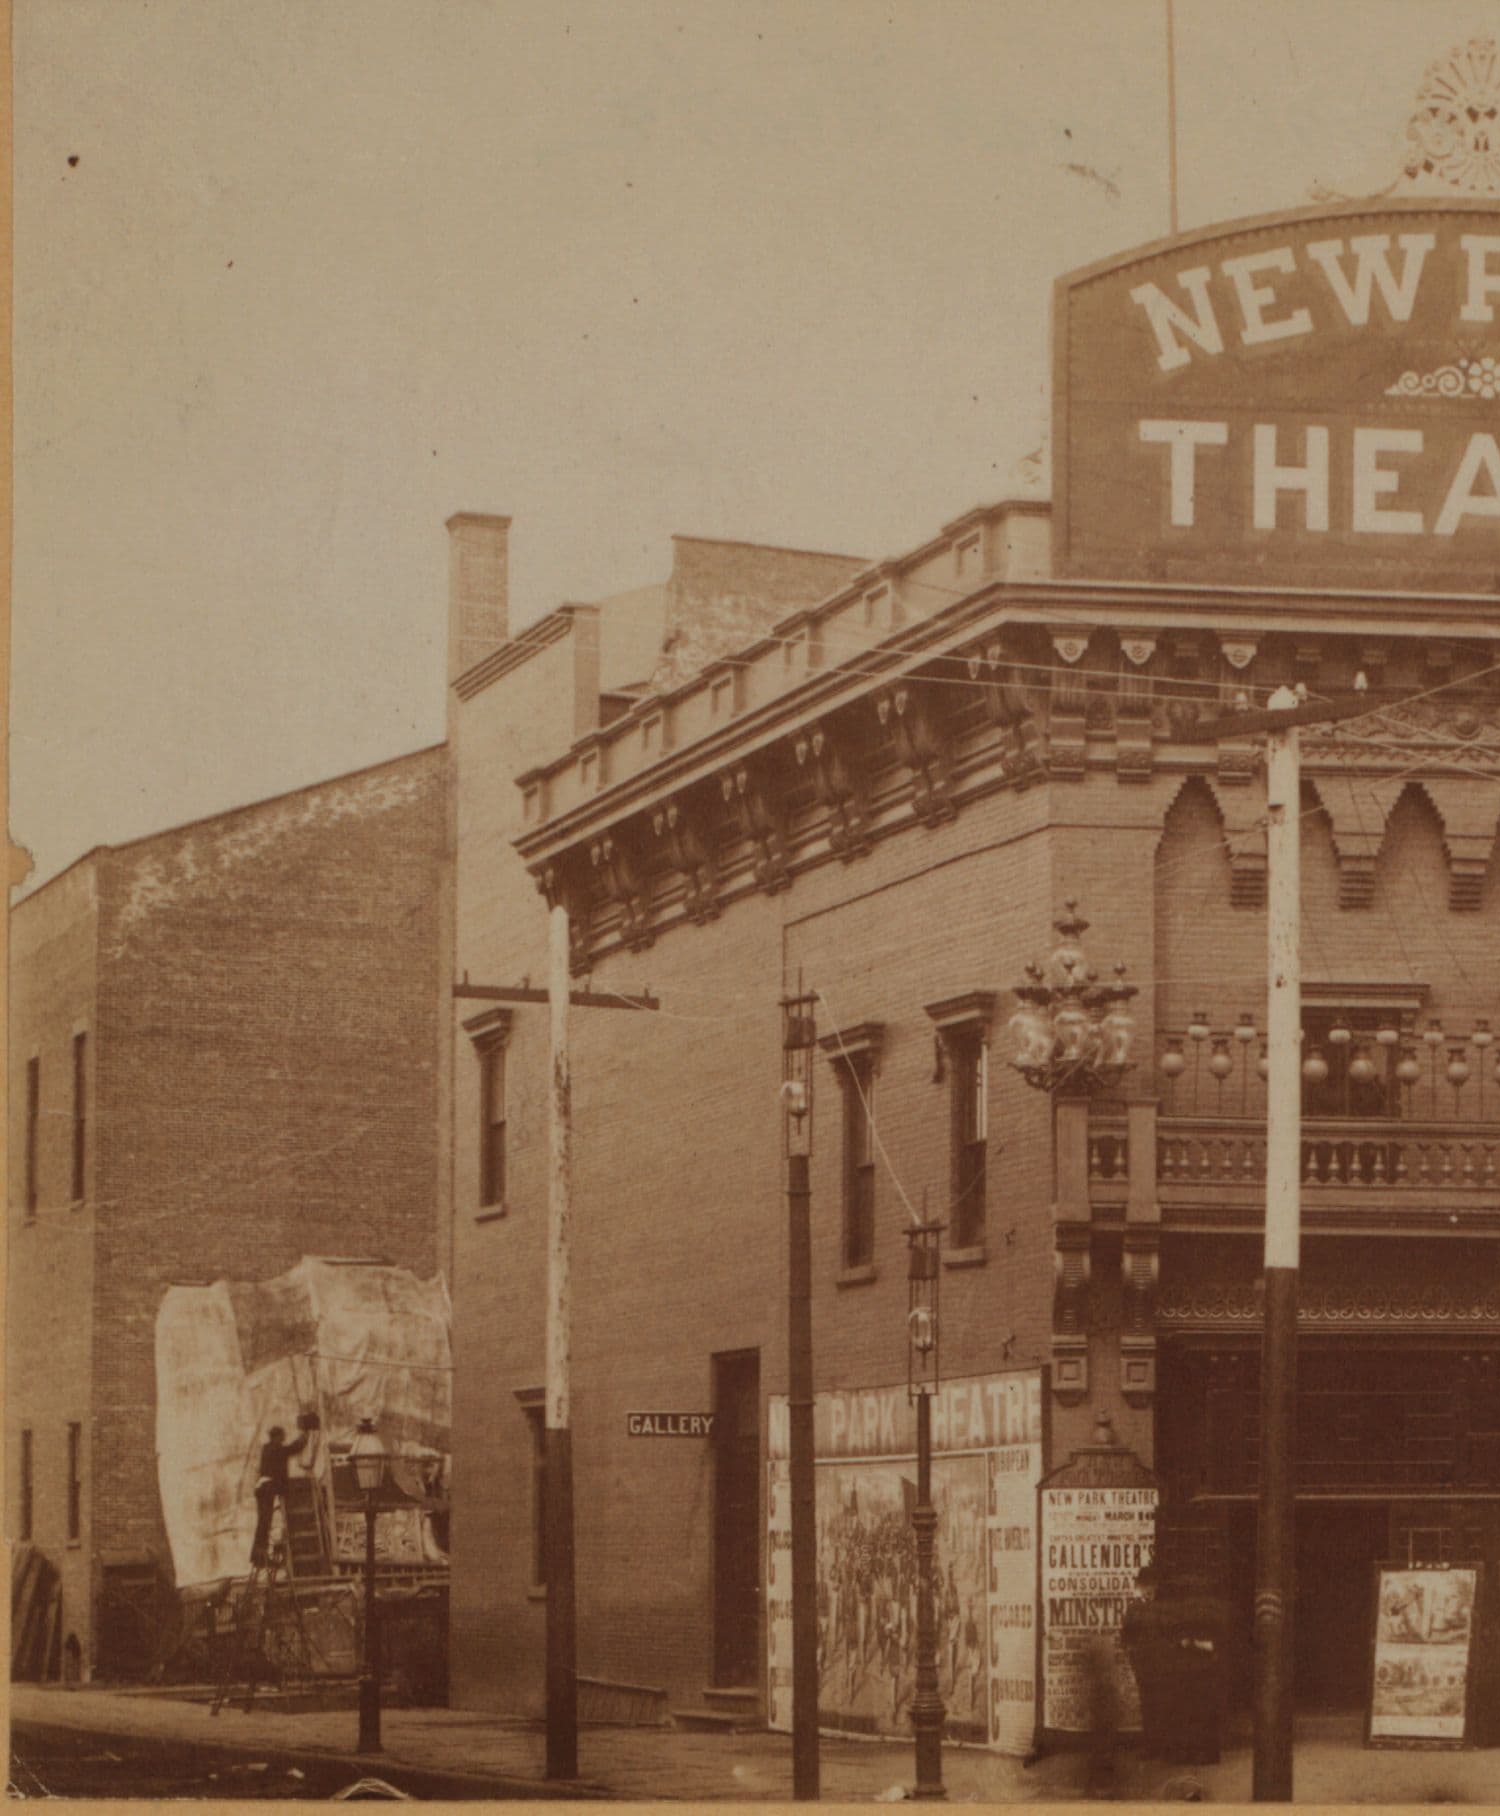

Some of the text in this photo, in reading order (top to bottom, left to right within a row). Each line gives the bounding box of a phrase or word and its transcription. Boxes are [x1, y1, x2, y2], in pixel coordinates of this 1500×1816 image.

[1130, 232, 1436, 372] NEW
[628, 1415, 714, 1435] GALLERY
[830, 1394, 898, 1450] PARK
[912, 1380, 1042, 1449] HEATRE
[1048, 1490, 1157, 1507] NEW PARK THEATRE
[1047, 1543, 1156, 1569] CALLENDER'S
